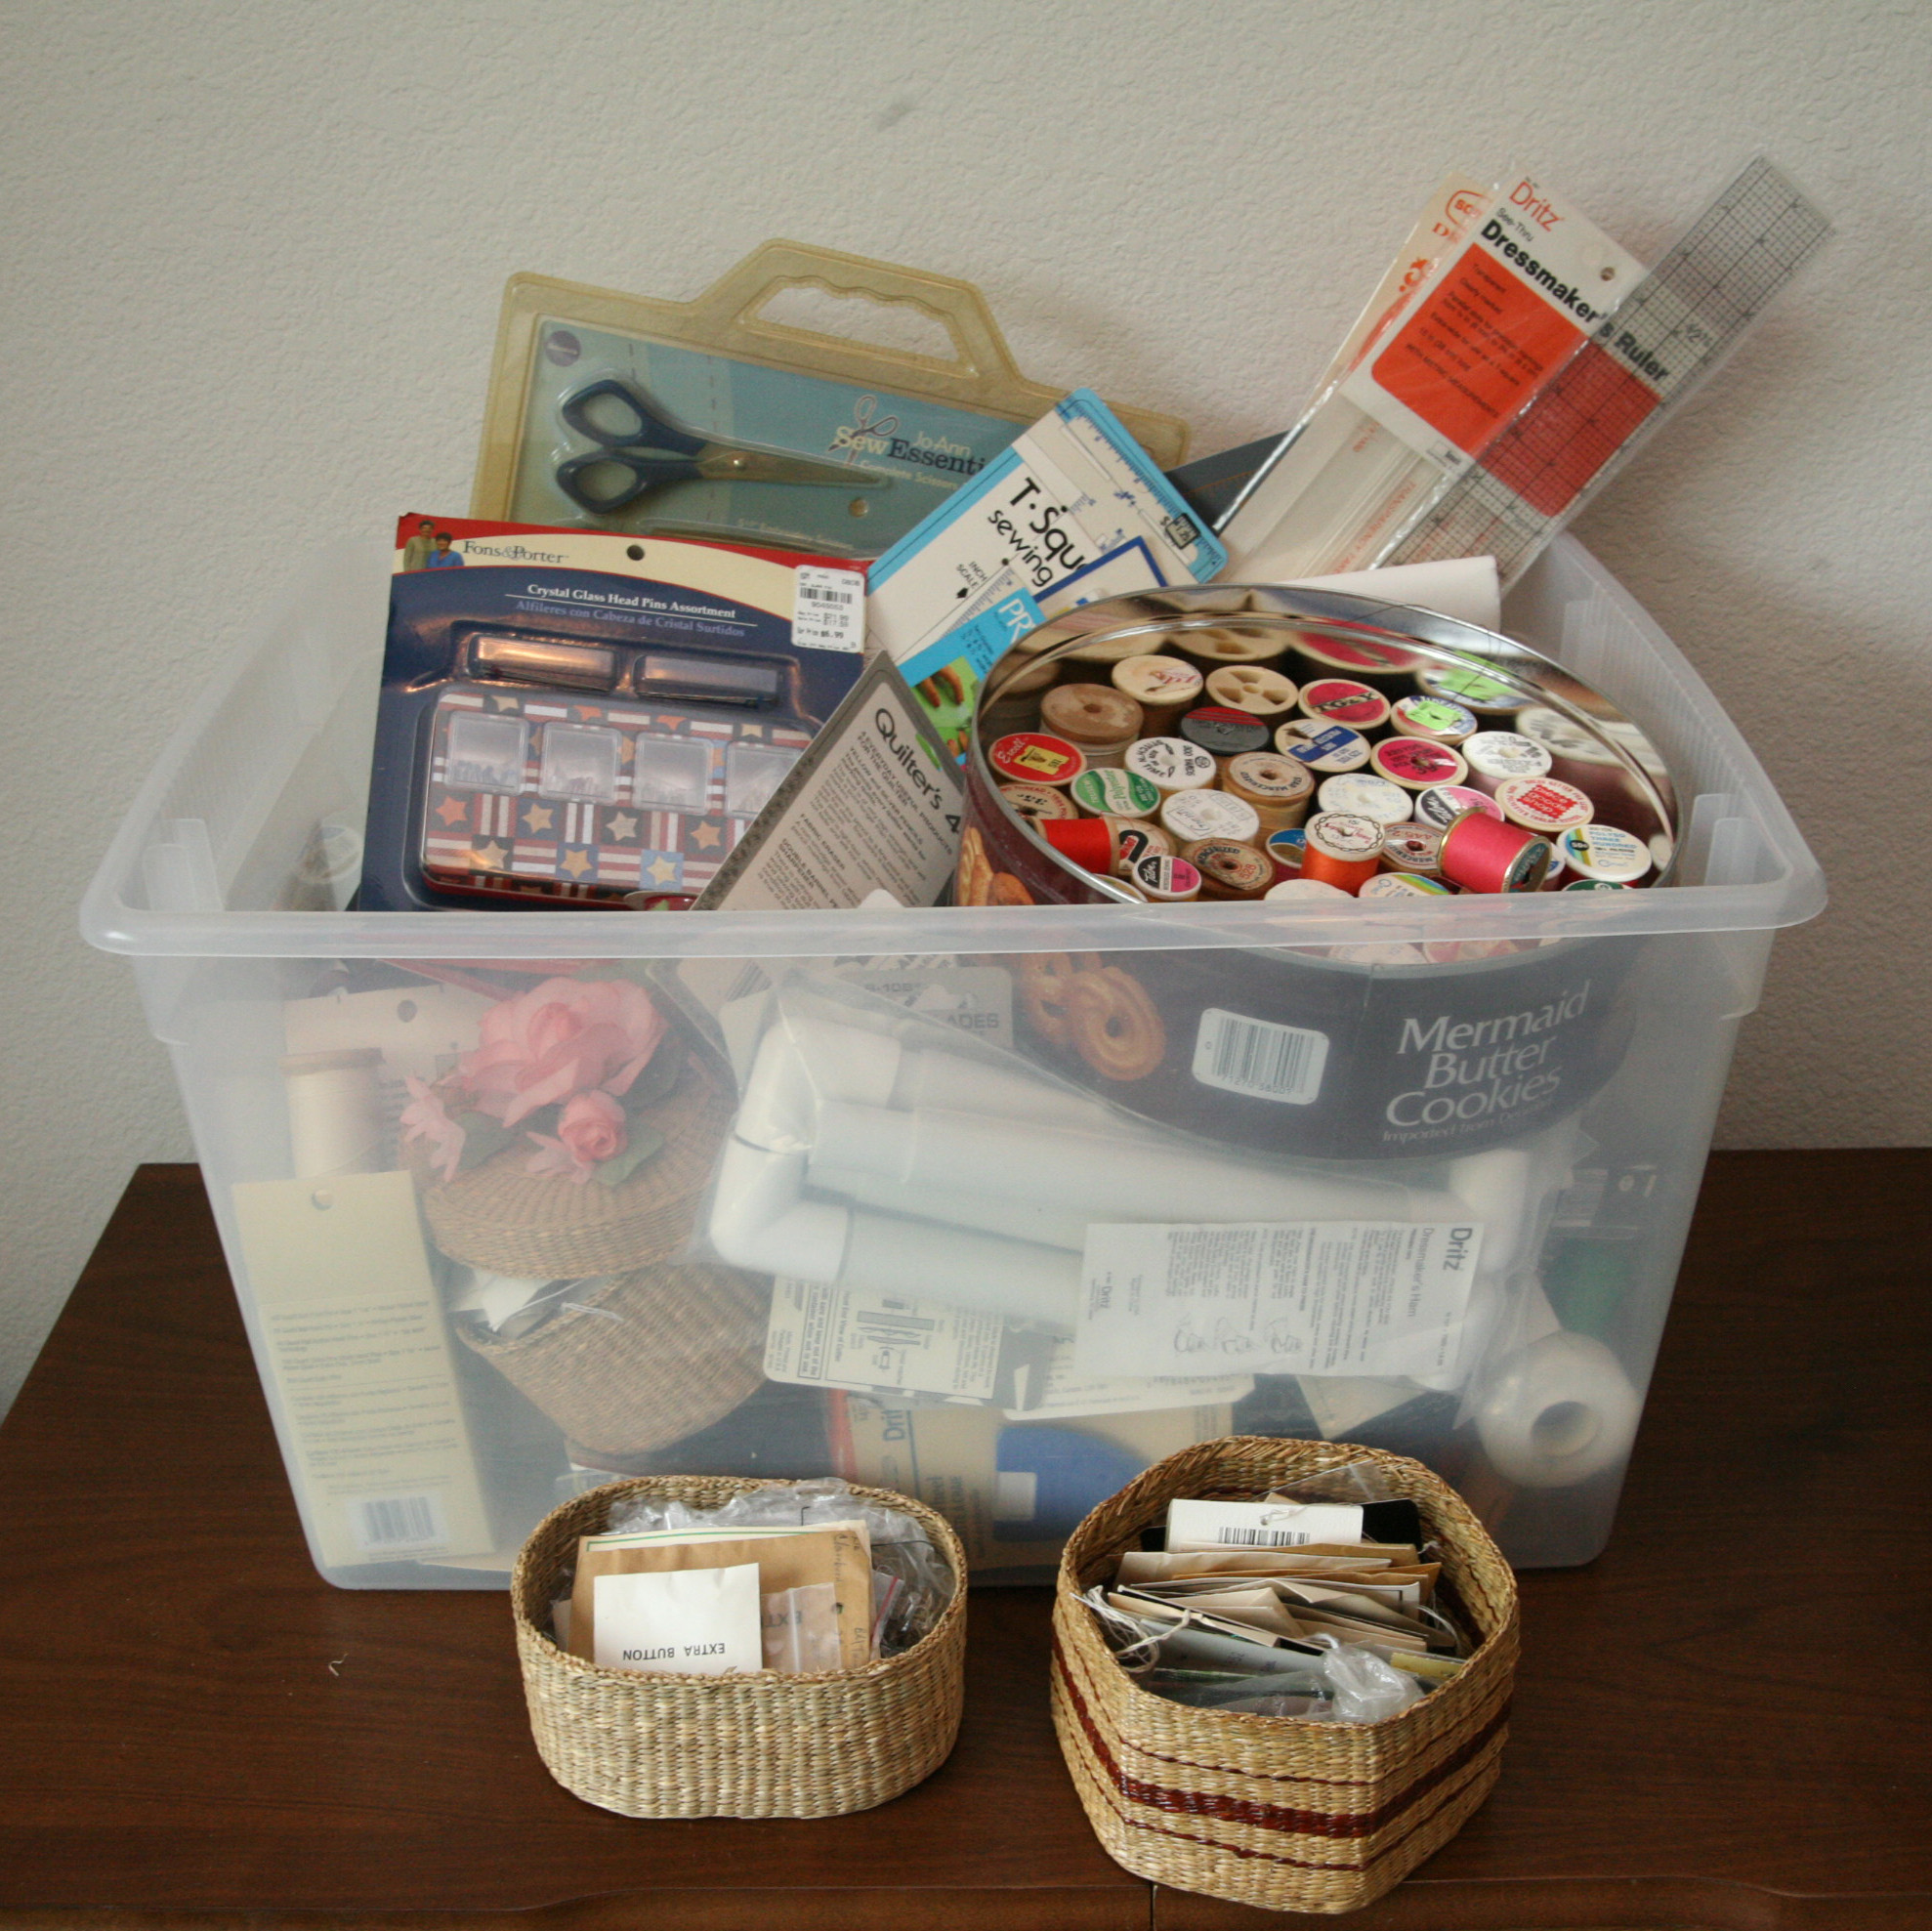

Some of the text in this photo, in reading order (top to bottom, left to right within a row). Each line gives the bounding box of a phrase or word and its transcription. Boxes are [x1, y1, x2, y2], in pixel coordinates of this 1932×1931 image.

[1495, 206, 1535, 242] See-Thru
[1509, 181, 1562, 231] Dritz
[1480, 219, 1614, 337] Dressmaker's
[1615, 331, 1671, 383] Ruler
[967, 560, 988, 582] INCH
[987, 510, 1053, 587] sewing
[953, 563, 981, 590] SCALE
[514, 599, 745, 637] Alfileres con Cabeza de Cristal Surtidos
[525, 582, 735, 619] Crystal Glass Head Pins Assortment
[1313, 691, 1374, 713] TG&Y
[856, 735, 908, 807] FOR THE QUILTER
[874, 708, 962, 833] Quilter's 4
[1143, 764, 1167, 777] TIME
[862, 735, 898, 780] EVERYDAY
[918, 811, 953, 856] PRODUCTS
[1527, 790, 1568, 812] goods
[1533, 785, 1569, 804] piece
[799, 812, 846, 870] FABRIC ERASER
[777, 842, 815, 889] SHARPENER
[1396, 980, 1592, 1055] Mermaid
[1424, 1032, 1556, 1089] Butter
[1386, 1067, 1562, 1127] Cookies
[1407, 1226, 1433, 1318] Dressmaker's Ham
[1442, 1227, 1473, 1272] Dritz
[878, 1407, 907, 1443] Drit
[621, 1642, 725, 1661] EXTRA BUTTON
